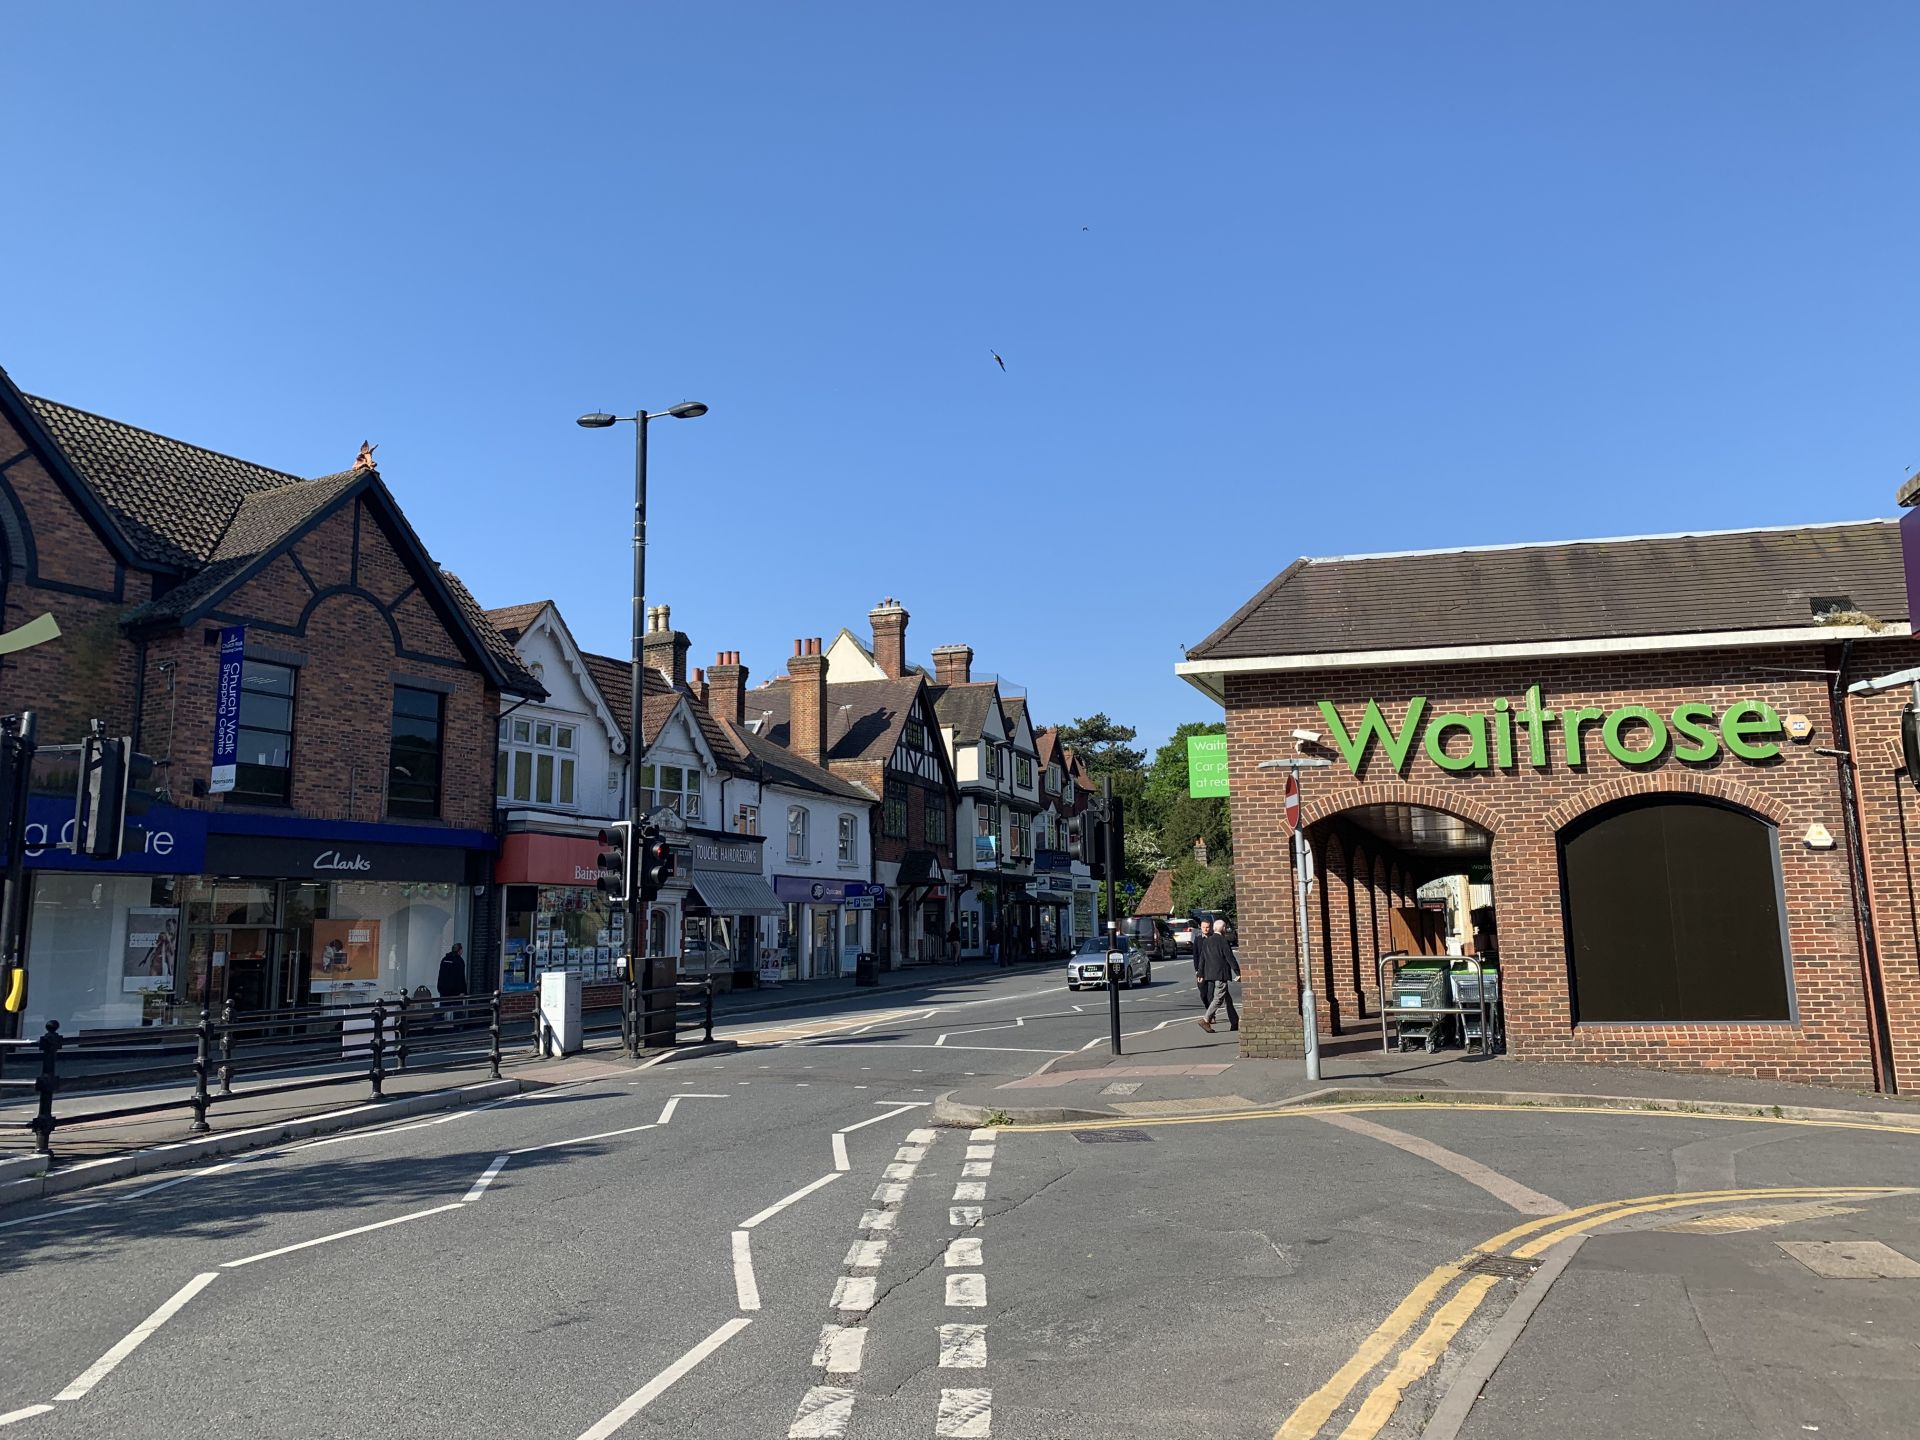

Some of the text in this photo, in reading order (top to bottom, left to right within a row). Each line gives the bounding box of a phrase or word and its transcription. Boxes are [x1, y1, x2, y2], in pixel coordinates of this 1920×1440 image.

[227, 662, 240, 717] Church
[217, 663, 231, 755] Shopping Centre
[224, 719, 237, 754] Walk
[1317, 684, 1782, 773] Waitrose
[1194, 740, 1227, 751] Waitr
[1195, 762, 1214, 772] Car
[1196, 777, 1230, 788] at rea
[313, 850, 371, 871] Clarks
[720, 848, 757, 864] HAIRDRESSING
[575, 865, 609, 881] Bairsto
